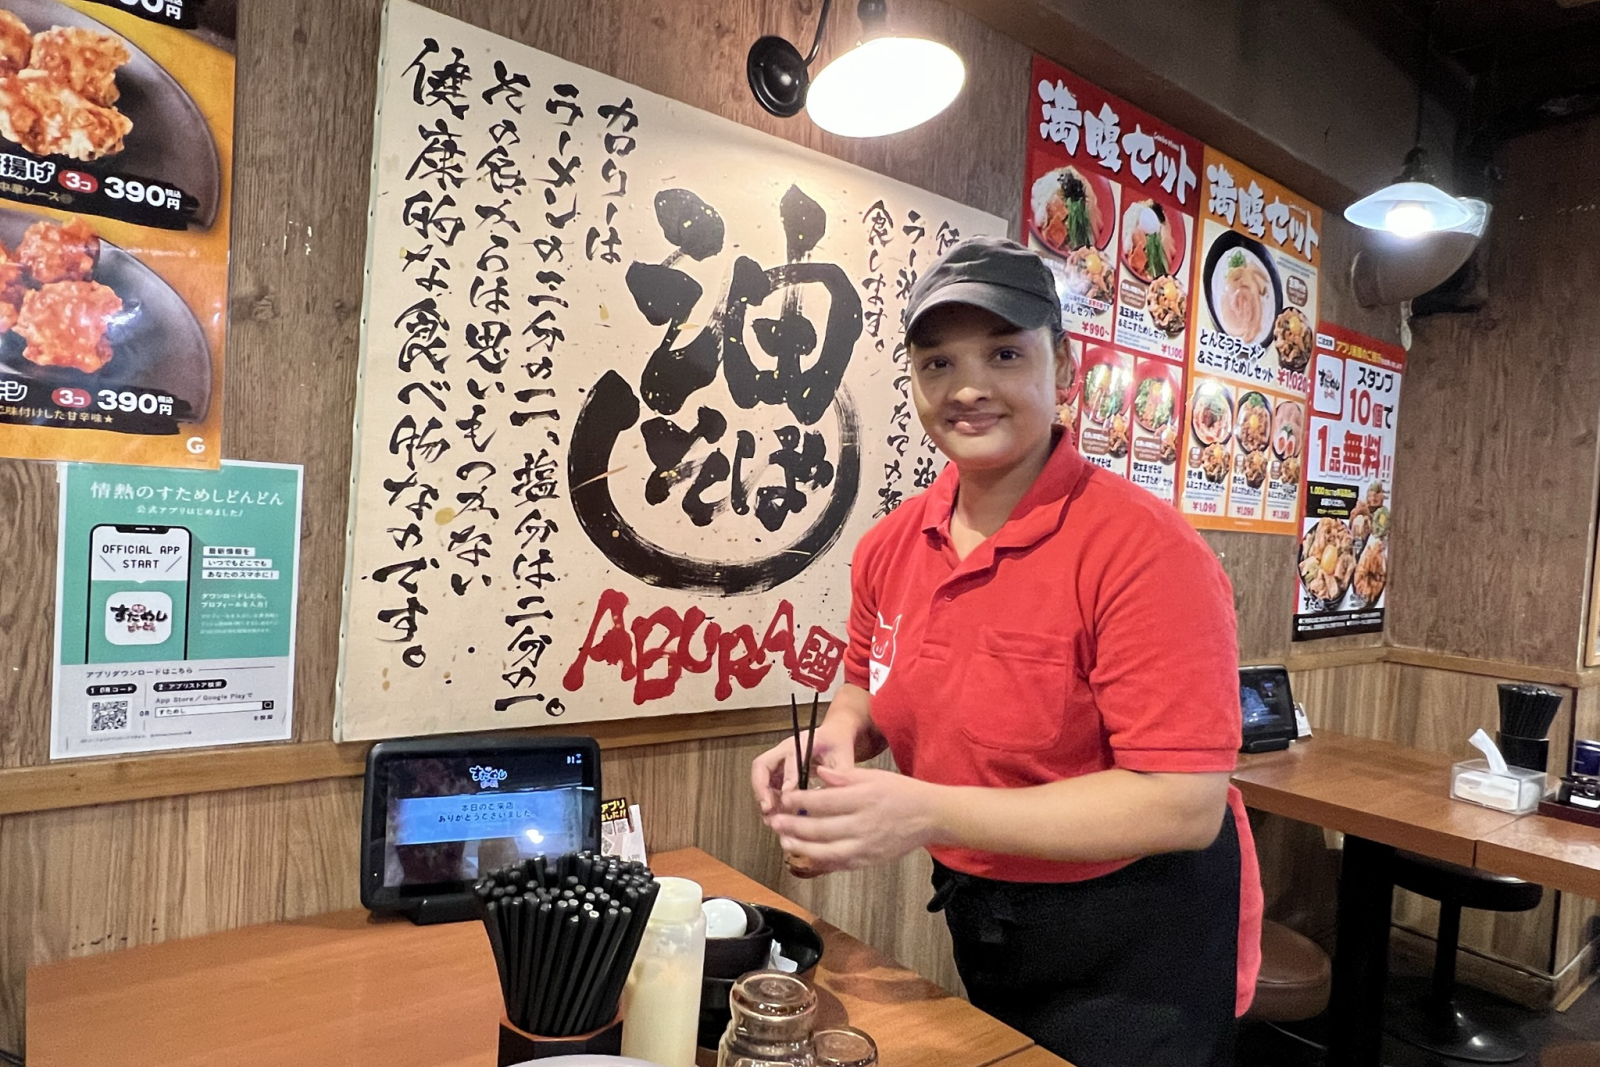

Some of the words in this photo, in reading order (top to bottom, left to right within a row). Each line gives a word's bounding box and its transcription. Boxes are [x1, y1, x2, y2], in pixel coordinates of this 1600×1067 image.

[1038, 79, 1197, 204] 満腹セット
[65, 172, 92, 190] 3コ
[586, 97, 639, 264] カロリーは
[1206, 163, 1319, 261] 満腹セット
[625, 184, 864, 425] 油
[1198, 350, 1274, 383] &ミニすためしセット
[1357, 366, 1394, 393] スタンプ
[59, 389, 85, 406] 3コ
[640, 406, 834, 533] そば
[90, 481, 285, 506] 情熱のすためしどんどん
[102, 544, 153, 555] OFFICIAL
[160, 545, 181, 555] APP
[122, 559, 160, 569] START
[110, 604, 168, 623] すためし
[562, 588, 798, 705] ABURA
[86, 668, 193, 679] アプリダウンロードはこちら
[202, 693, 228, 702] Google
